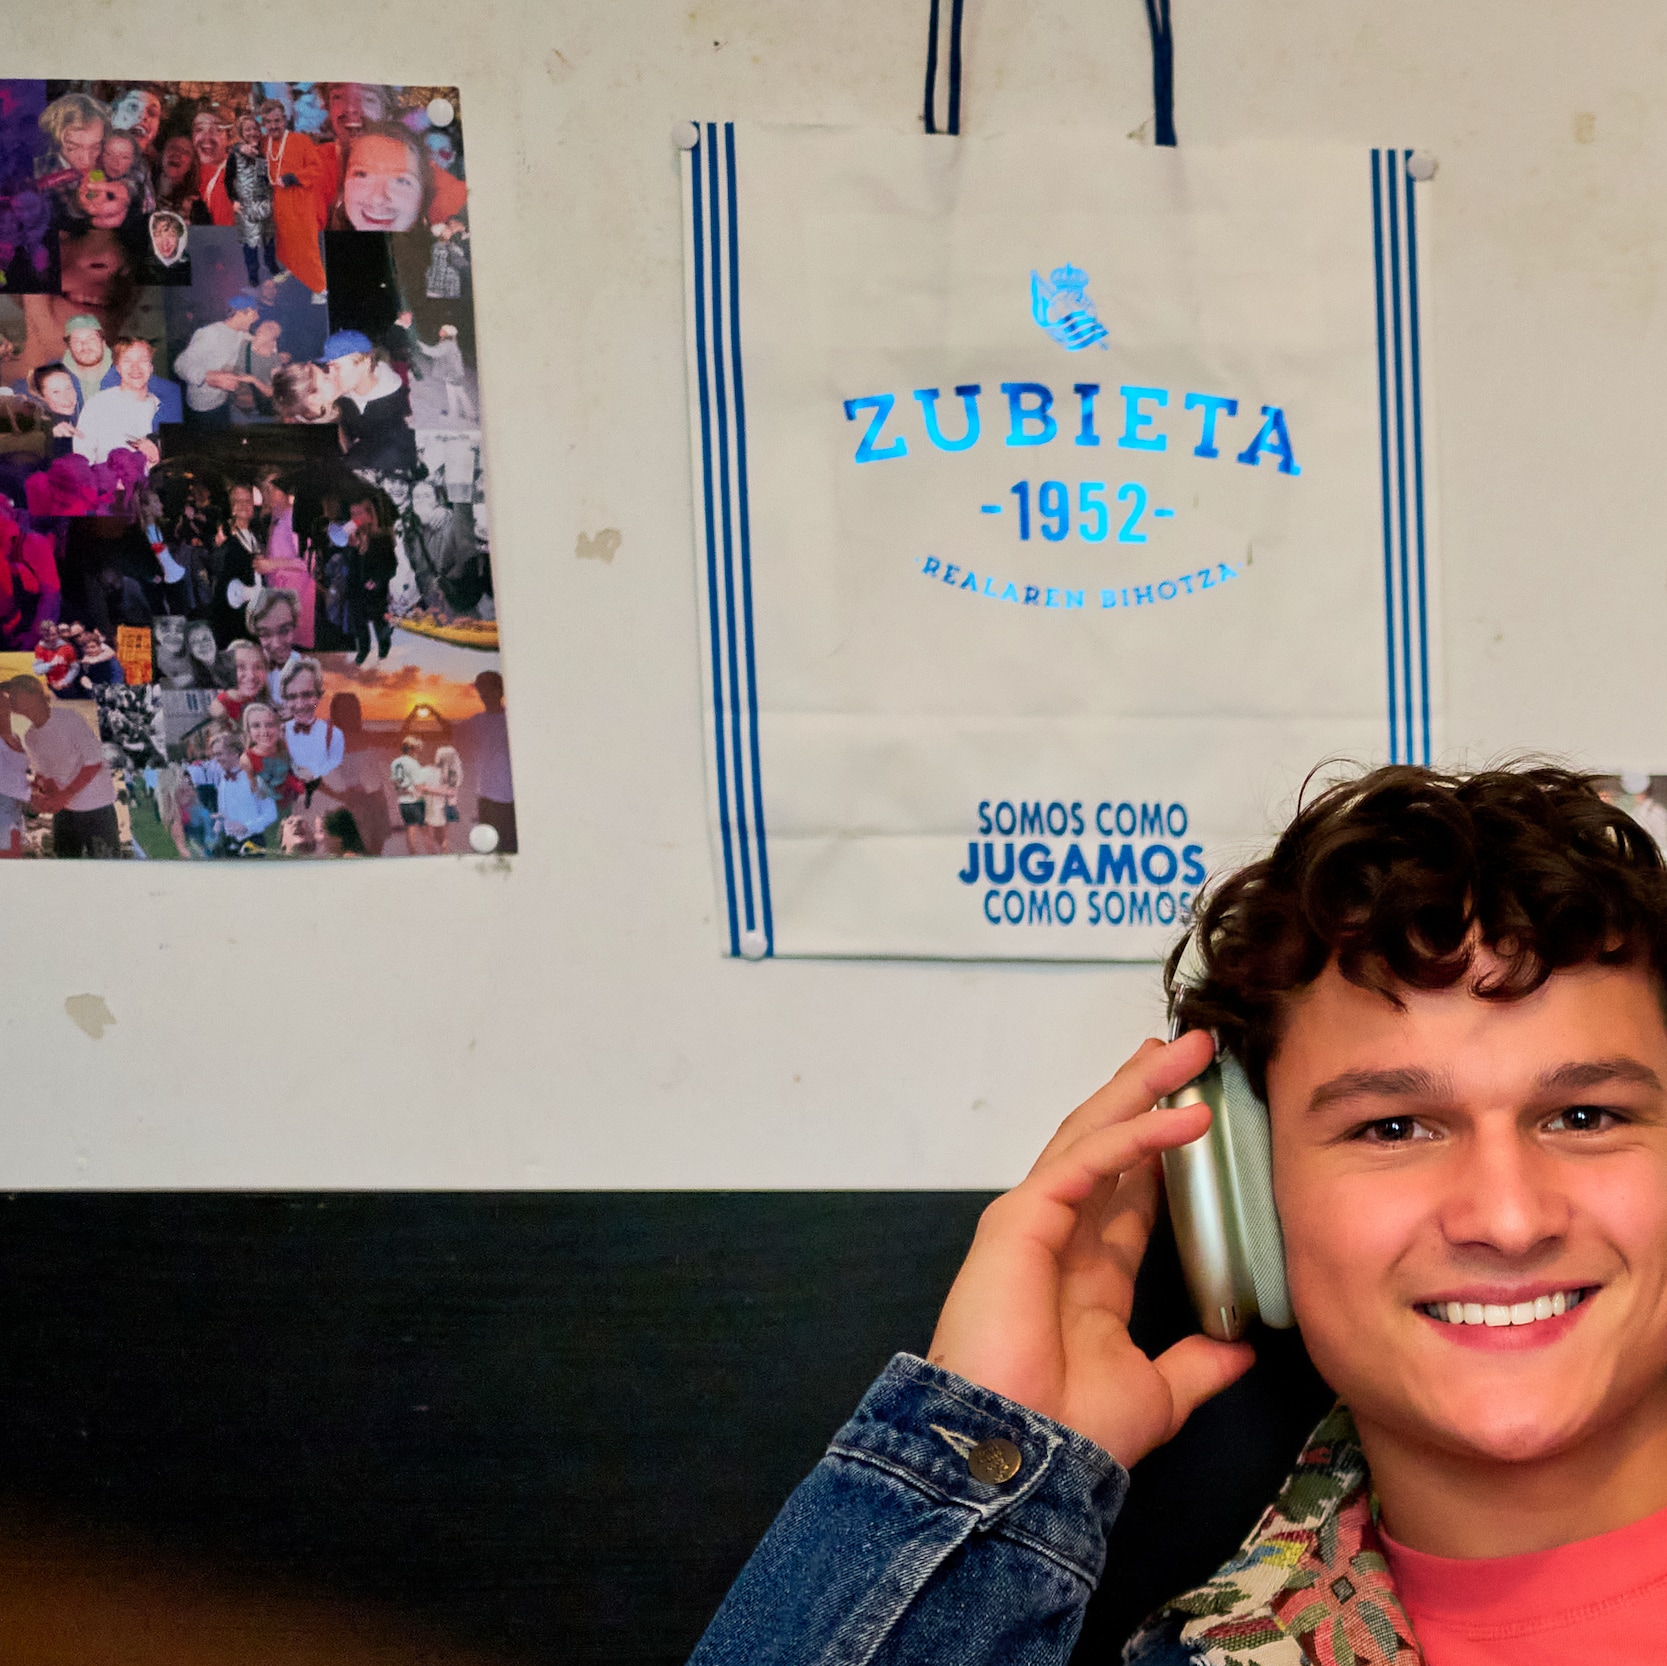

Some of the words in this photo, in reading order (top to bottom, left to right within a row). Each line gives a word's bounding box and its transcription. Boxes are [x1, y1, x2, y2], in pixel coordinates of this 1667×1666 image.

[842, 382, 1301, 476] ZUBIETA
[921, 555, 1085, 609] REALAREN
[1100, 561, 1239, 609] BIHOTZA
[978, 801, 1085, 837] SOMOS
[1096, 802, 1188, 837] COMO
[958, 842, 1206, 886] JUGAMOS
[984, 889, 1075, 926] COMO
